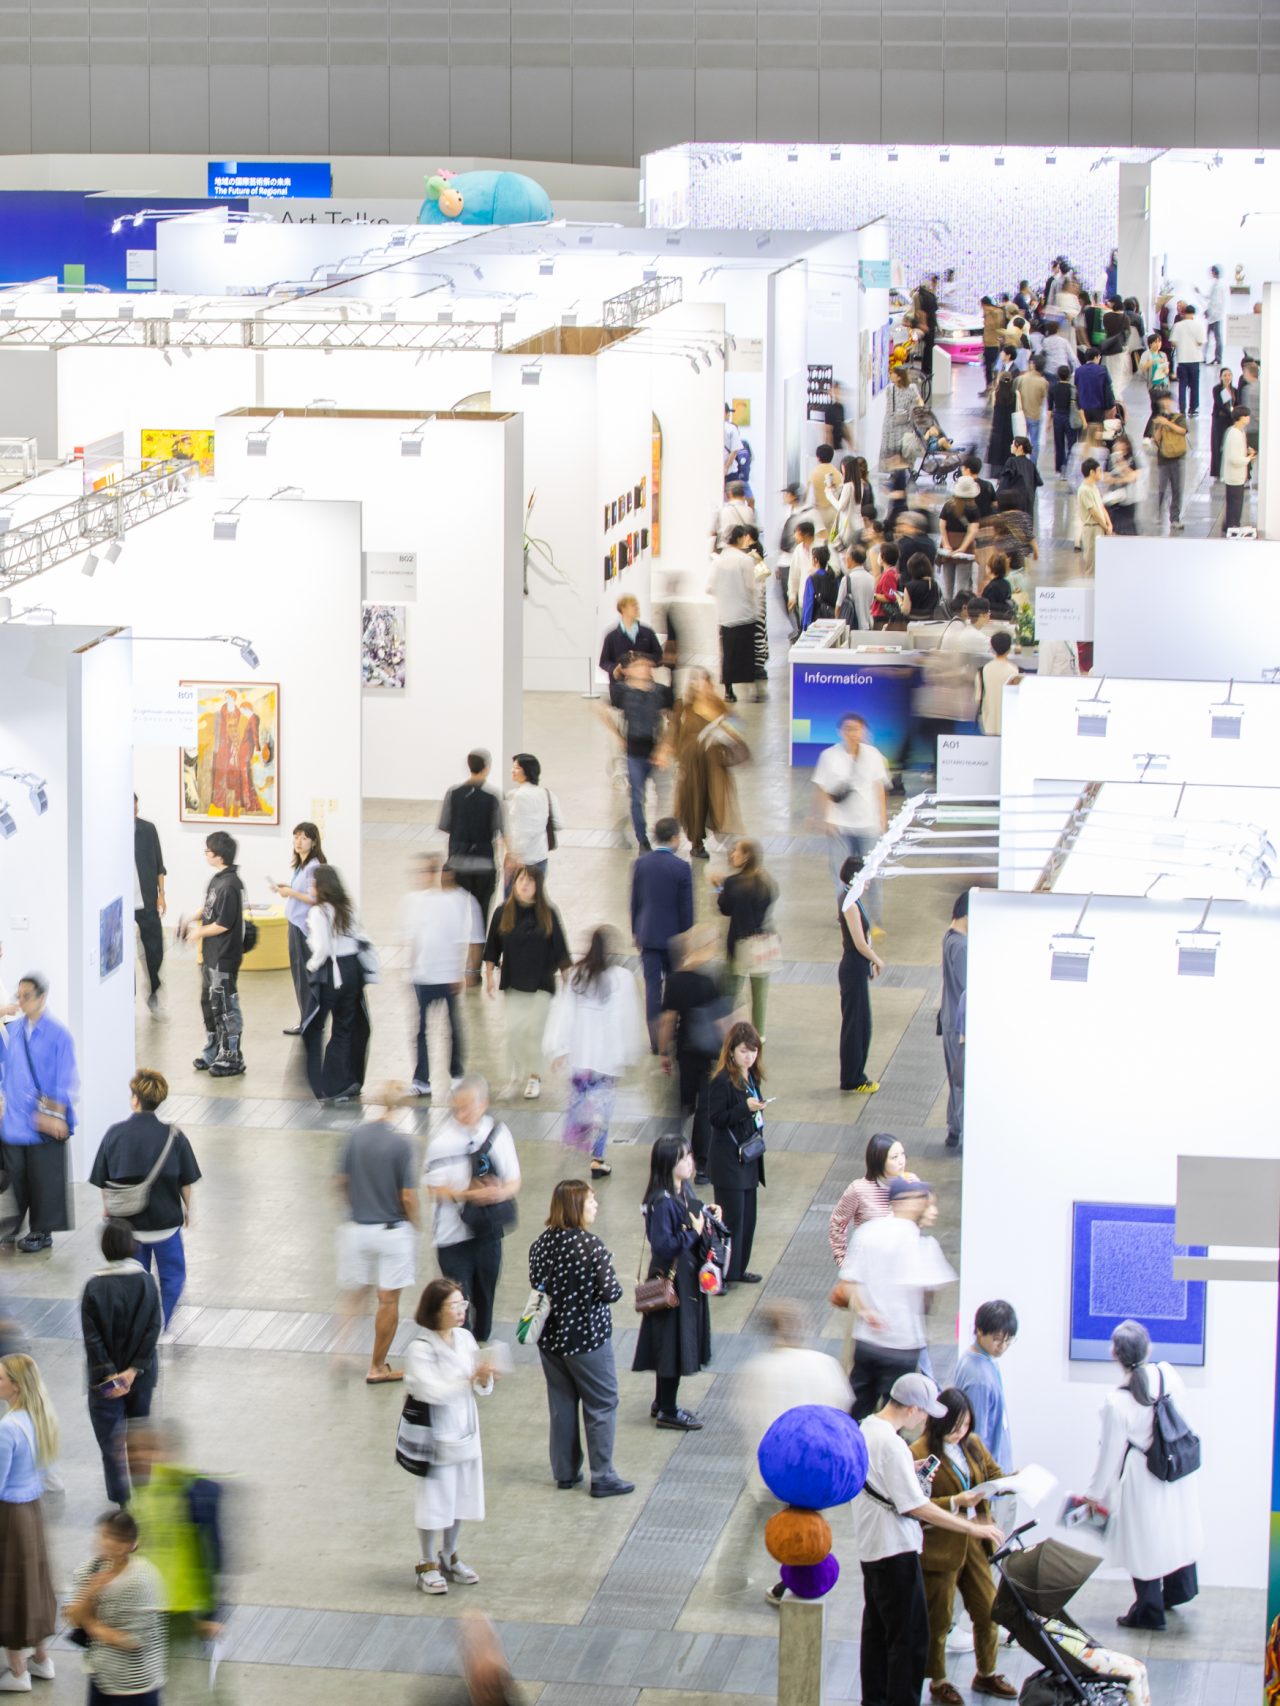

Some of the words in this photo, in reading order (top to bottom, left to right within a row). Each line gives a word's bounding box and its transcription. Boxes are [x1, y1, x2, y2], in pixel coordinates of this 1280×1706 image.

[214, 187, 228, 195] The
[228, 187, 250, 195] Future
[251, 187, 258, 195] of
[259, 187, 288, 197] Regional
[1039, 591, 1056, 599] A02
[804, 671, 873, 685] Information
[177, 691, 193, 700] B01
[942, 740, 960, 749] A01
